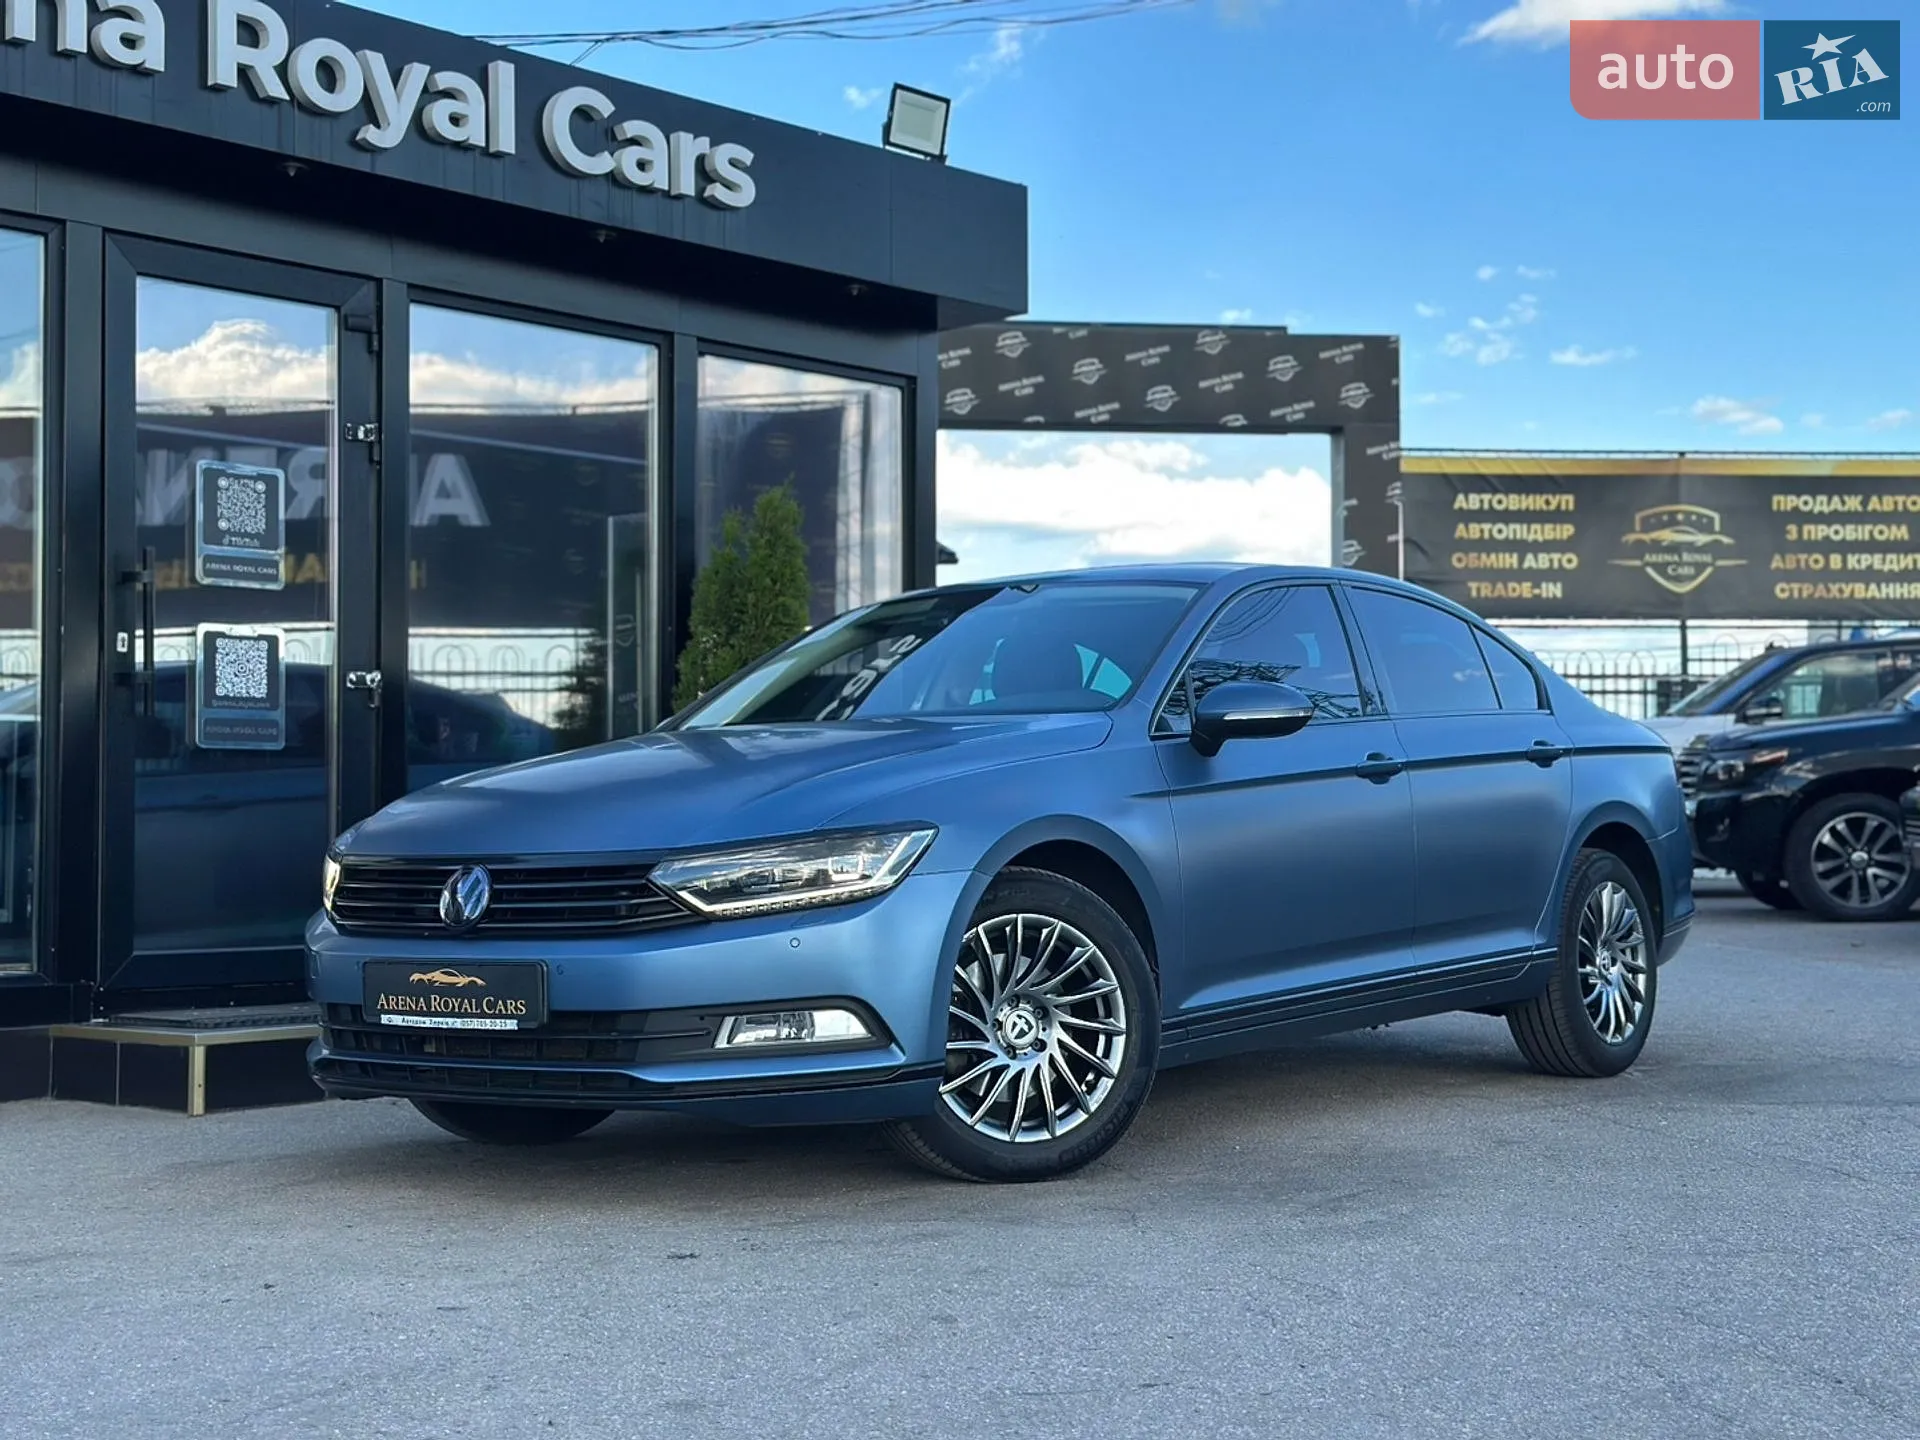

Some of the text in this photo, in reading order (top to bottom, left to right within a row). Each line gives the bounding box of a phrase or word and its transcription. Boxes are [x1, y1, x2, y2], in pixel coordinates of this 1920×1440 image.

[206, 0, 515, 156] Royal
[542, 86, 756, 208] Cars
[1453, 492, 1575, 511] АВТОВИКУП
[1772, 494, 1920, 514] ПРОДАЖ АВТО
[1454, 522, 1575, 542] АВТОПІДБІР
[1802, 523, 1909, 541] ПРОБІГОМ
[1451, 552, 1578, 569] ОБМІН АВТО
[1770, 553, 1825, 570] АВТО
[1829, 553, 1842, 570] В
[1467, 581, 1562, 598] TRADE-IN
[377, 993, 526, 1015] ARENA ROYAL CARS
